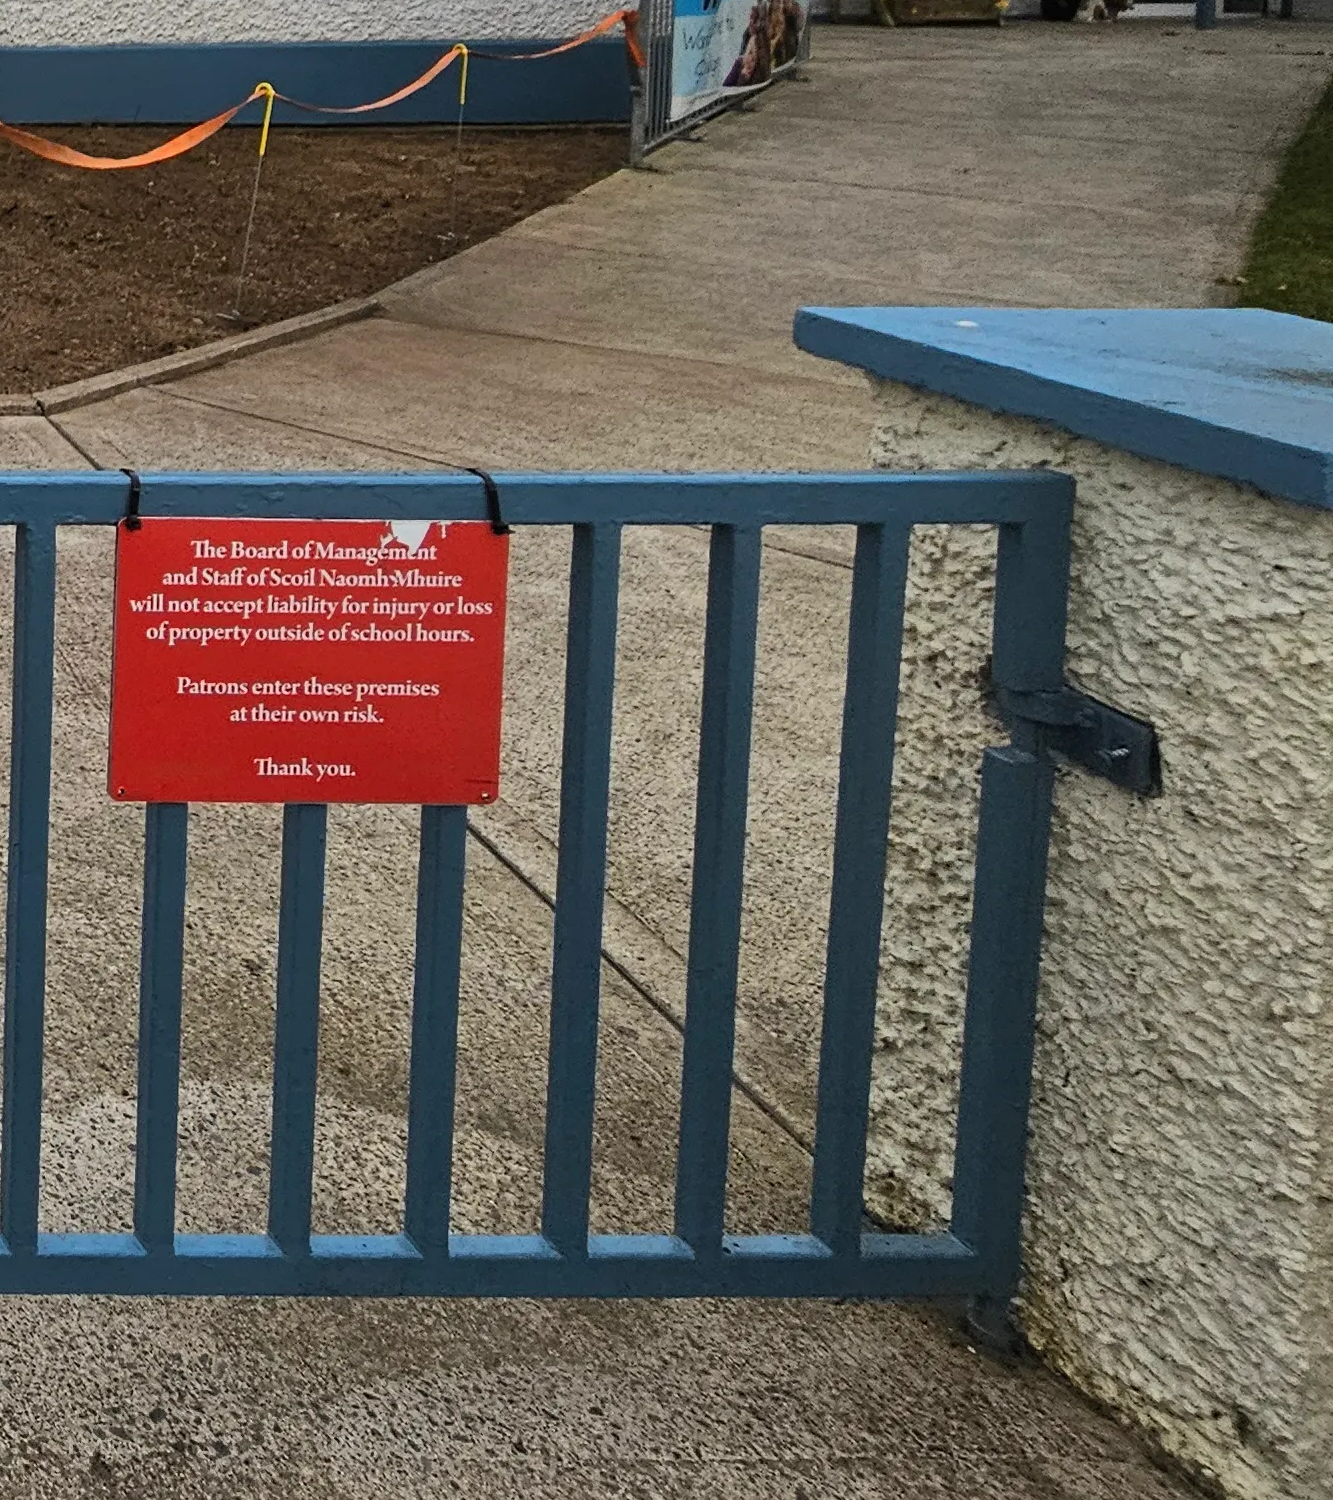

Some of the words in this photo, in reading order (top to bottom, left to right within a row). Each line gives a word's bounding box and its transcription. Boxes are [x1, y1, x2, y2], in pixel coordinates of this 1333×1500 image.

[191, 539, 227, 559] The
[230, 540, 288, 559] Board
[292, 540, 316, 559] of
[163, 567, 197, 585] and
[201, 567, 246, 585] Staff
[245, 567, 270, 586] of
[269, 568, 315, 586] Scoil
[319, 567, 390, 587] Naomh
[393, 569, 462, 587] Mhuire
[129, 594, 164, 612] will
[168, 598, 200, 612] not
[203, 598, 264, 619] accept
[267, 595, 337, 619] liability
[341, 595, 369, 614] for
[373, 598, 431, 620] injury
[433, 602, 455, 614] or
[457, 596, 492, 614] loss
[146, 621, 169, 639] of
[168, 622, 252, 646] property
[255, 623, 324, 641] outside
[328, 623, 351, 641] of
[351, 623, 412, 641] school
[416, 623, 474, 642] hours.
[177, 677, 248, 694] Patrons
[252, 681, 301, 695] enter
[304, 677, 353, 695] these
[356, 680, 439, 701] premises
[230, 707, 247, 721] at
[251, 703, 297, 722] their
[299, 710, 339, 722] own
[344, 704, 384, 722] risk.
[254, 757, 313, 776] Thank
[316, 765, 355, 782] you.
